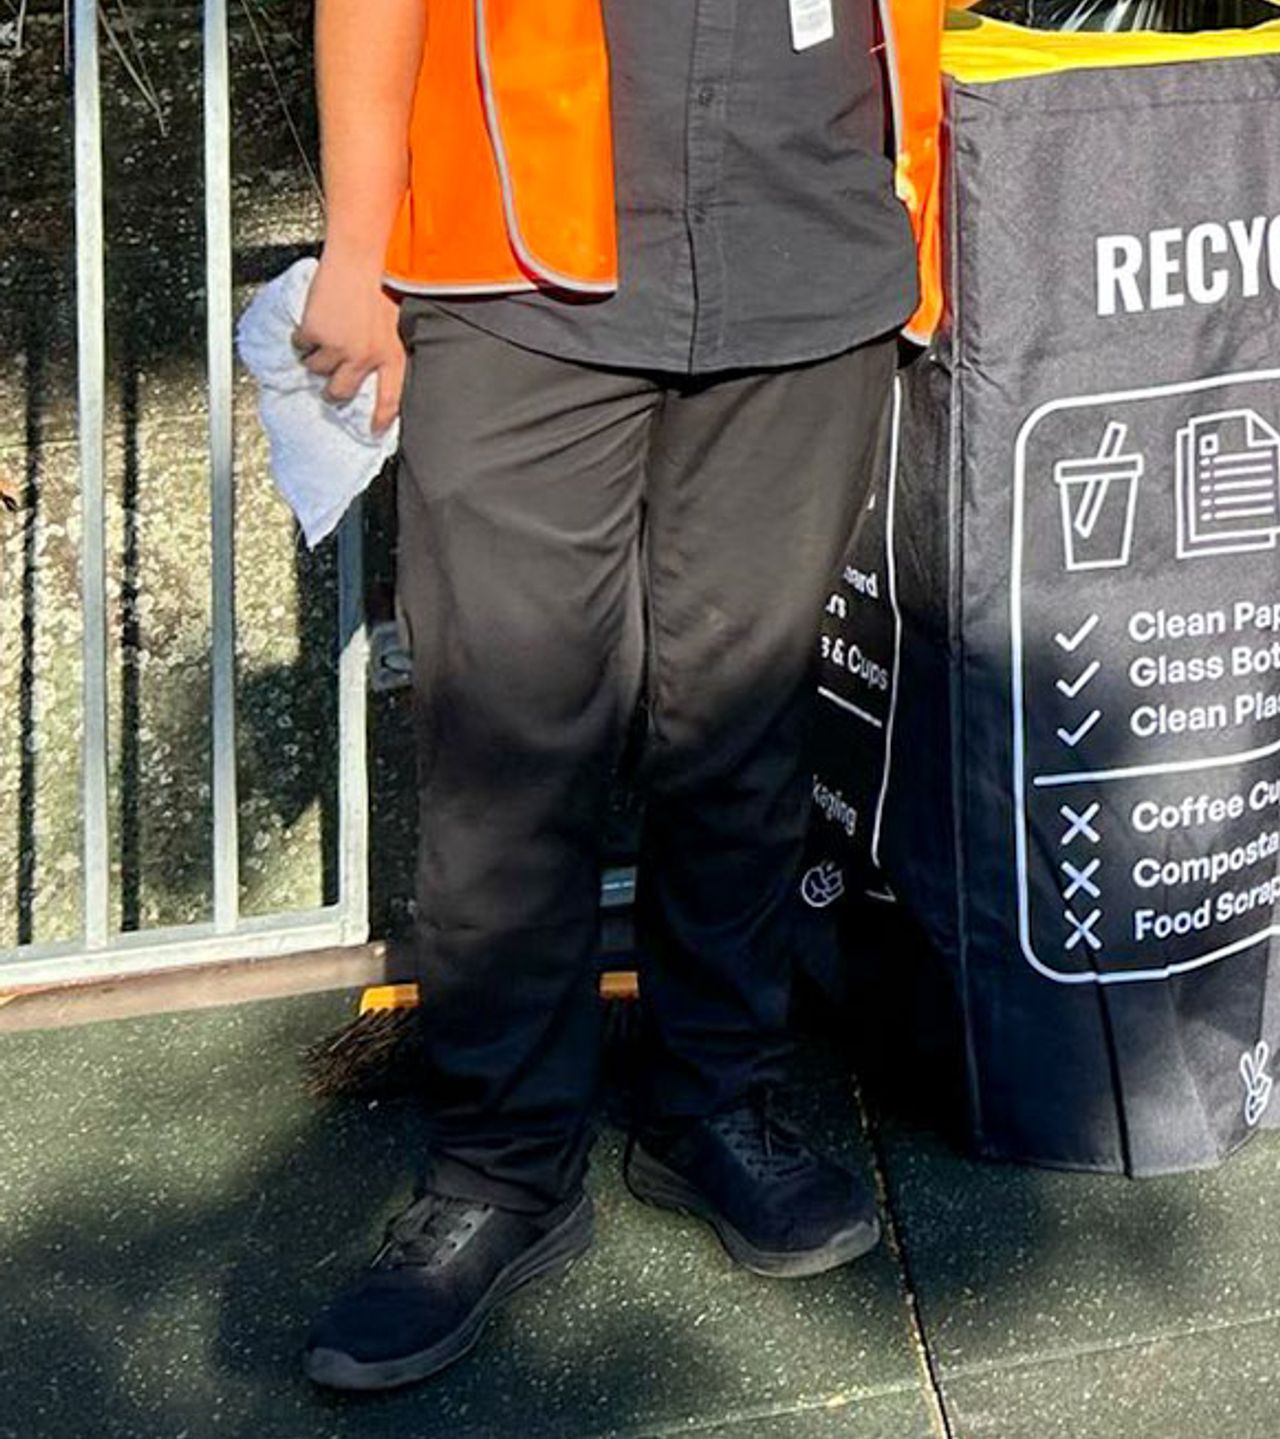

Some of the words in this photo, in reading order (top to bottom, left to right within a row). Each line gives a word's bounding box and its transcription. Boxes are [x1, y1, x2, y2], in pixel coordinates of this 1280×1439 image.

[1128, 609, 1226, 642] Clean
[847, 643, 889, 691] Cups
[1129, 655, 1225, 687] Glass
[1131, 703, 1227, 736] Clean
[1132, 794, 1244, 832] Coffee
[1135, 900, 1211, 940] Food
